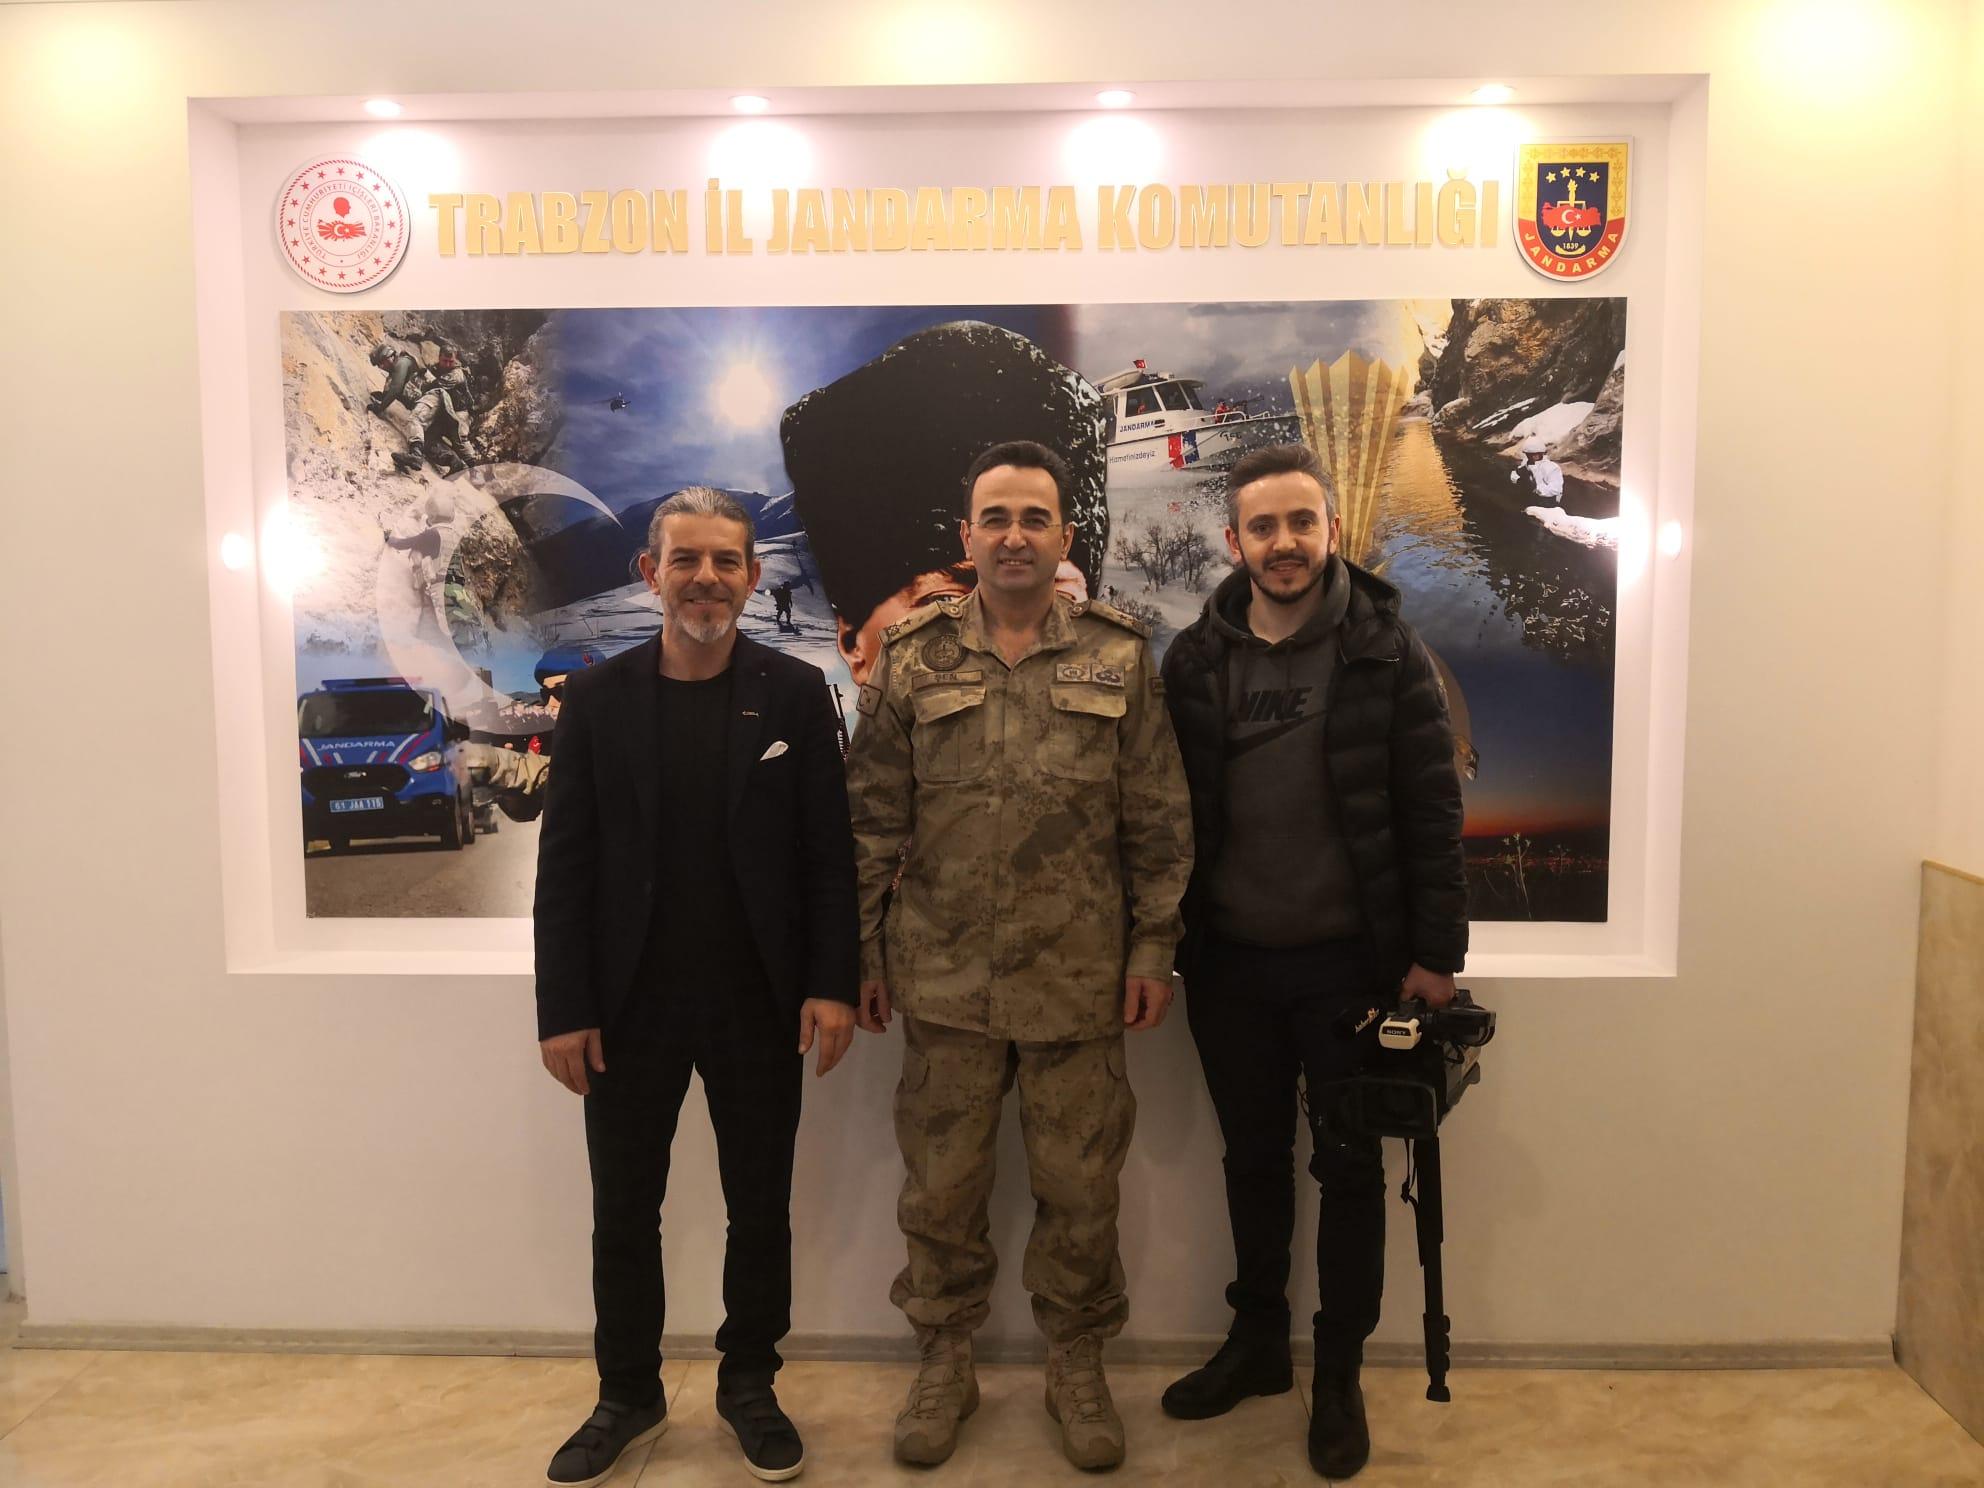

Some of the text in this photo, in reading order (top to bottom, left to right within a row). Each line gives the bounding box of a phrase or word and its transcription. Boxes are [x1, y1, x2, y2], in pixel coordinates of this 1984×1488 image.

[428, 168, 1498, 256] TRABZON İL JANDARMA KOMUTANLIĞI
[1525, 232, 1618, 273] JANDARMA
[1563, 242, 1579, 250] 1839
[1238, 686, 1313, 722] NIKE
[318, 740, 396, 751] JANDARMA
